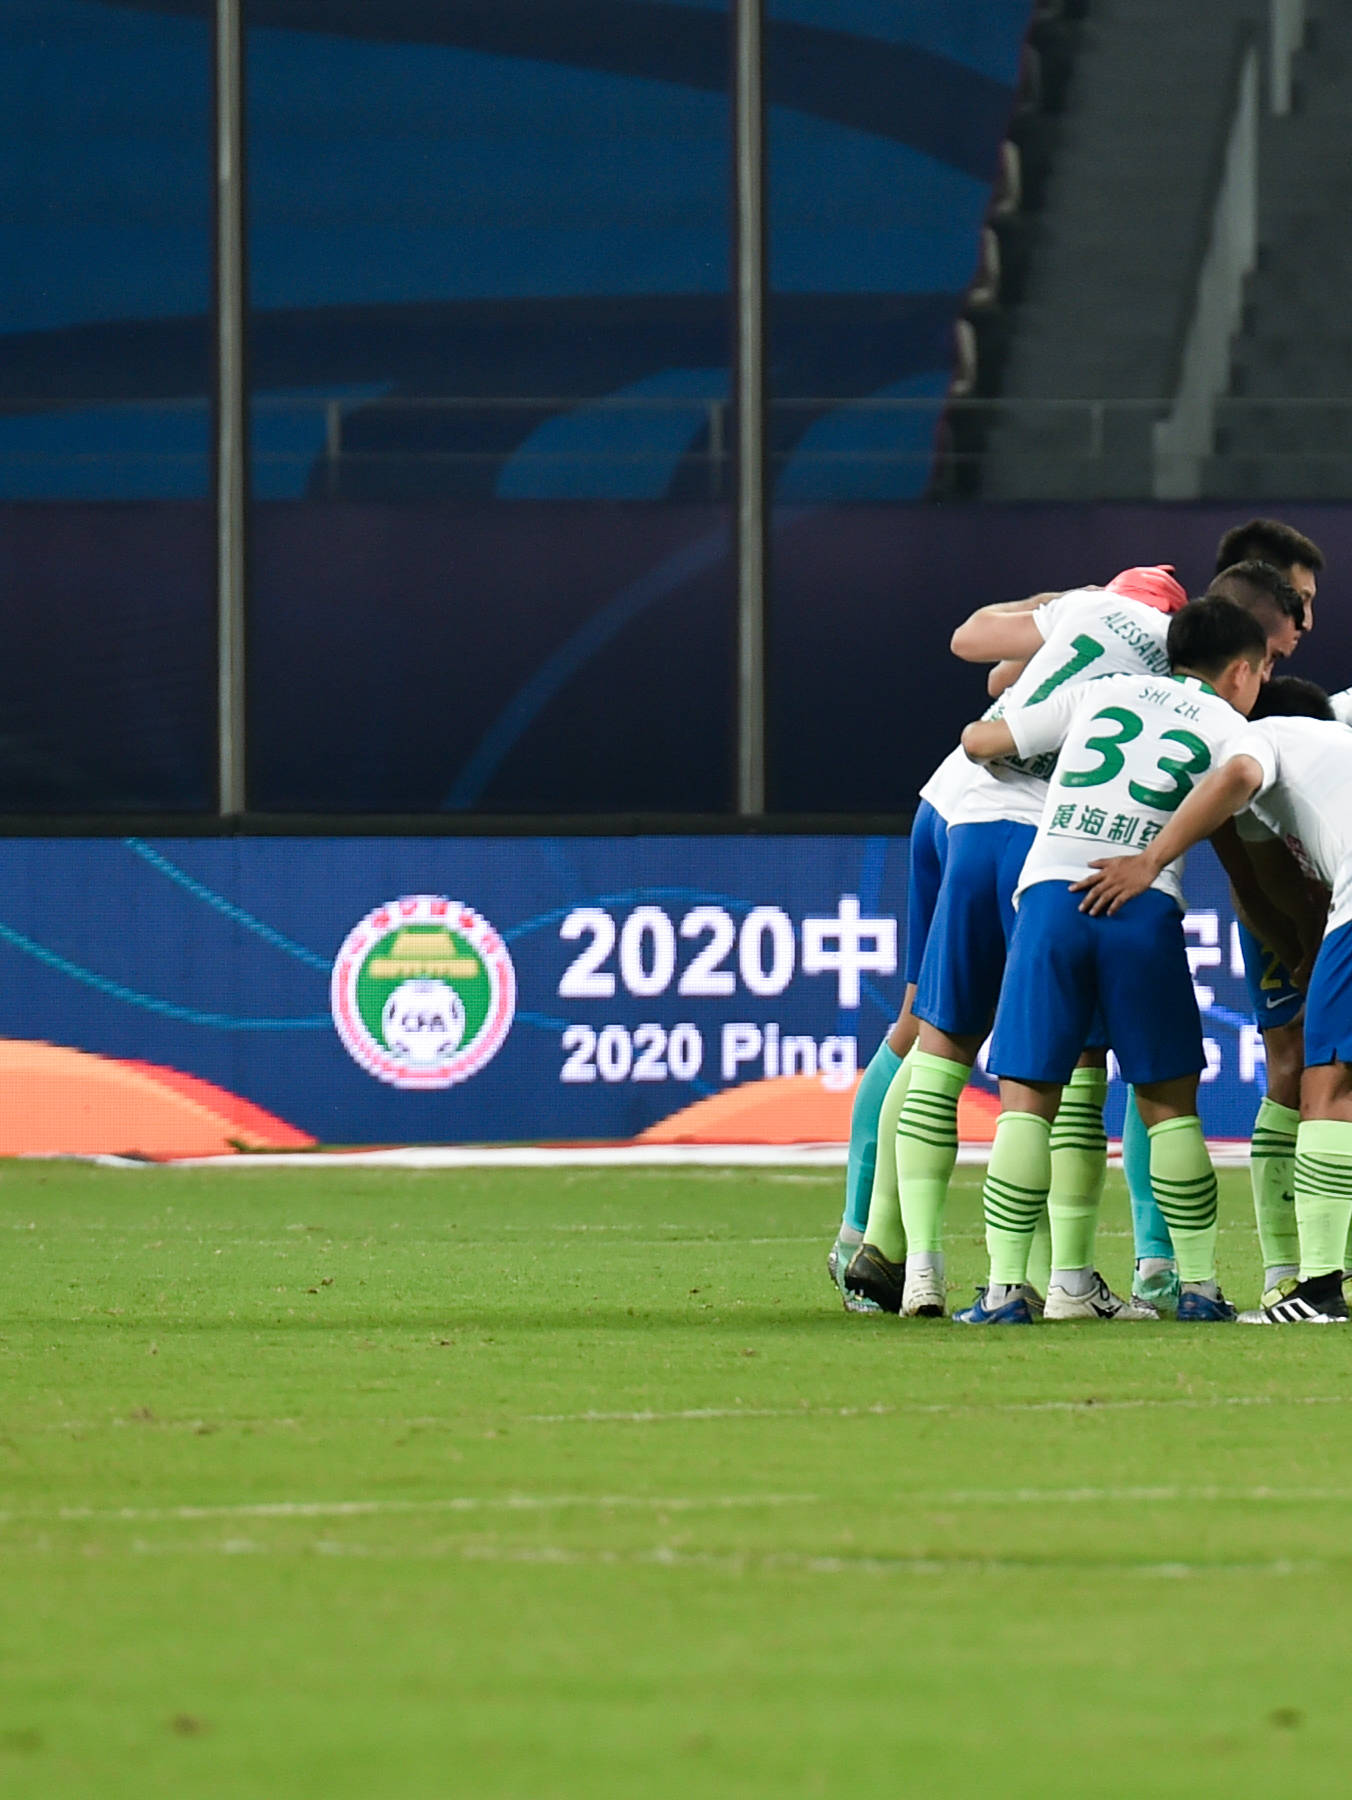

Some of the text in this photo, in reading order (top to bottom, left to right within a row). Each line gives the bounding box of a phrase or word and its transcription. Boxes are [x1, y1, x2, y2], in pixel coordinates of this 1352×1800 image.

[1100, 611, 1171, 677] ALESSAND
[1138, 685, 1171, 704] SHI
[1060, 706, 1211, 811] 33
[560, 1022, 703, 1081] 2020
[720, 1022, 858, 1091] Ping
